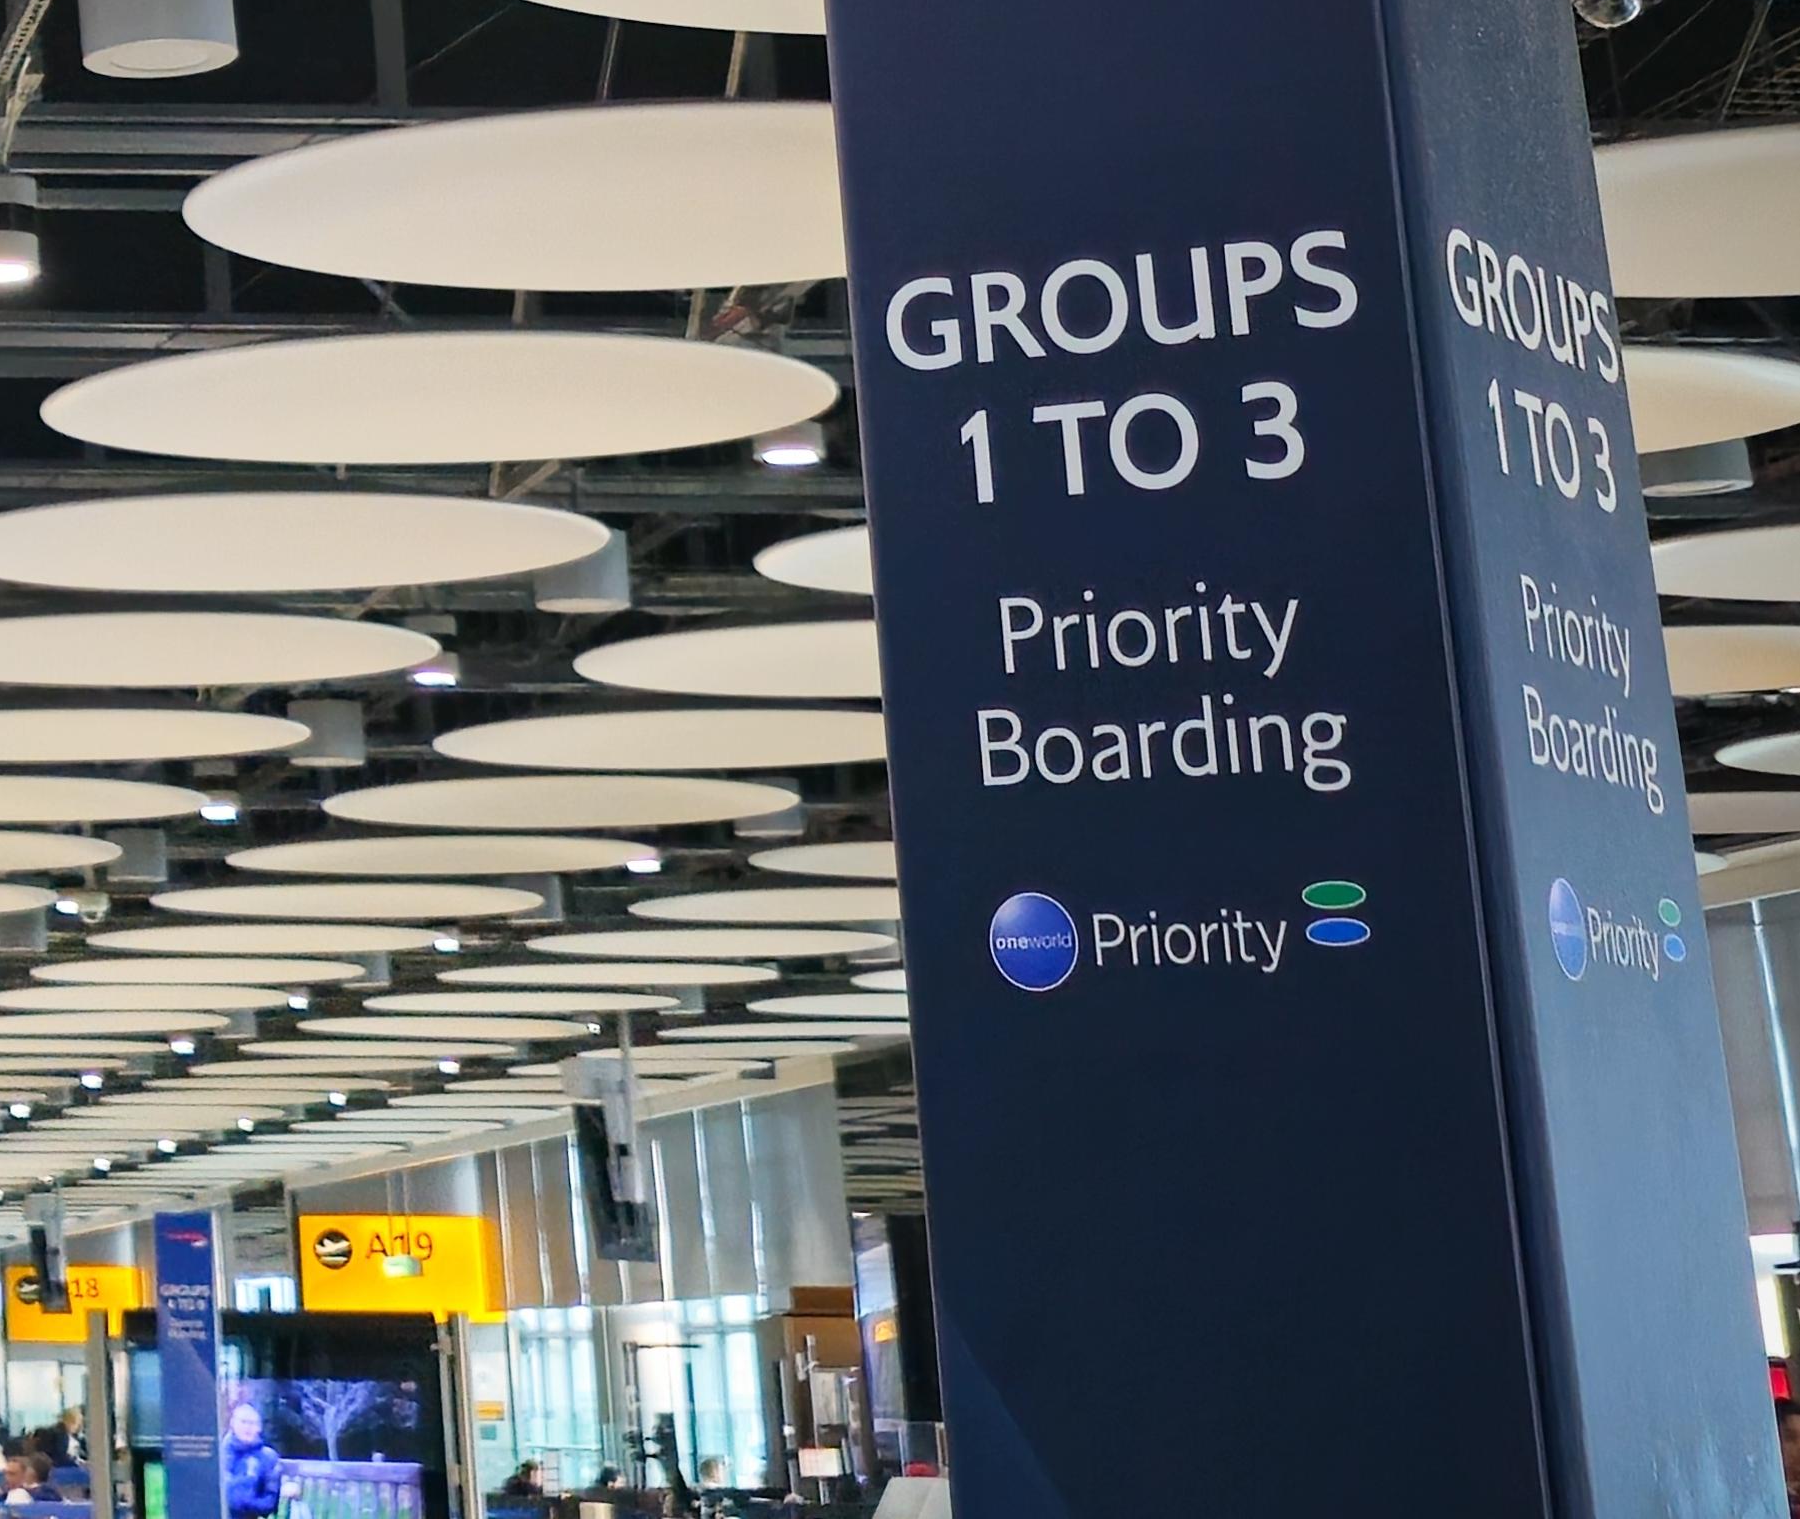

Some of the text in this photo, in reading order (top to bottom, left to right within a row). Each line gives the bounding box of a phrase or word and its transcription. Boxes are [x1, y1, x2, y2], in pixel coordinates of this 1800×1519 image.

[885, 229, 1359, 372] GROUPS
[1445, 227, 1620, 384] GROUPS
[959, 380, 1306, 505] 1 TO 3
[1488, 377, 1617, 513] 1 TO 3
[998, 580, 1300, 680] Priority
[1519, 573, 1631, 699] Priority
[976, 692, 1353, 793] Boarding
[1522, 682, 1665, 815] Boarding
[995, 907, 1288, 974] oneworld Priority
[1586, 906, 1660, 983] Priority
